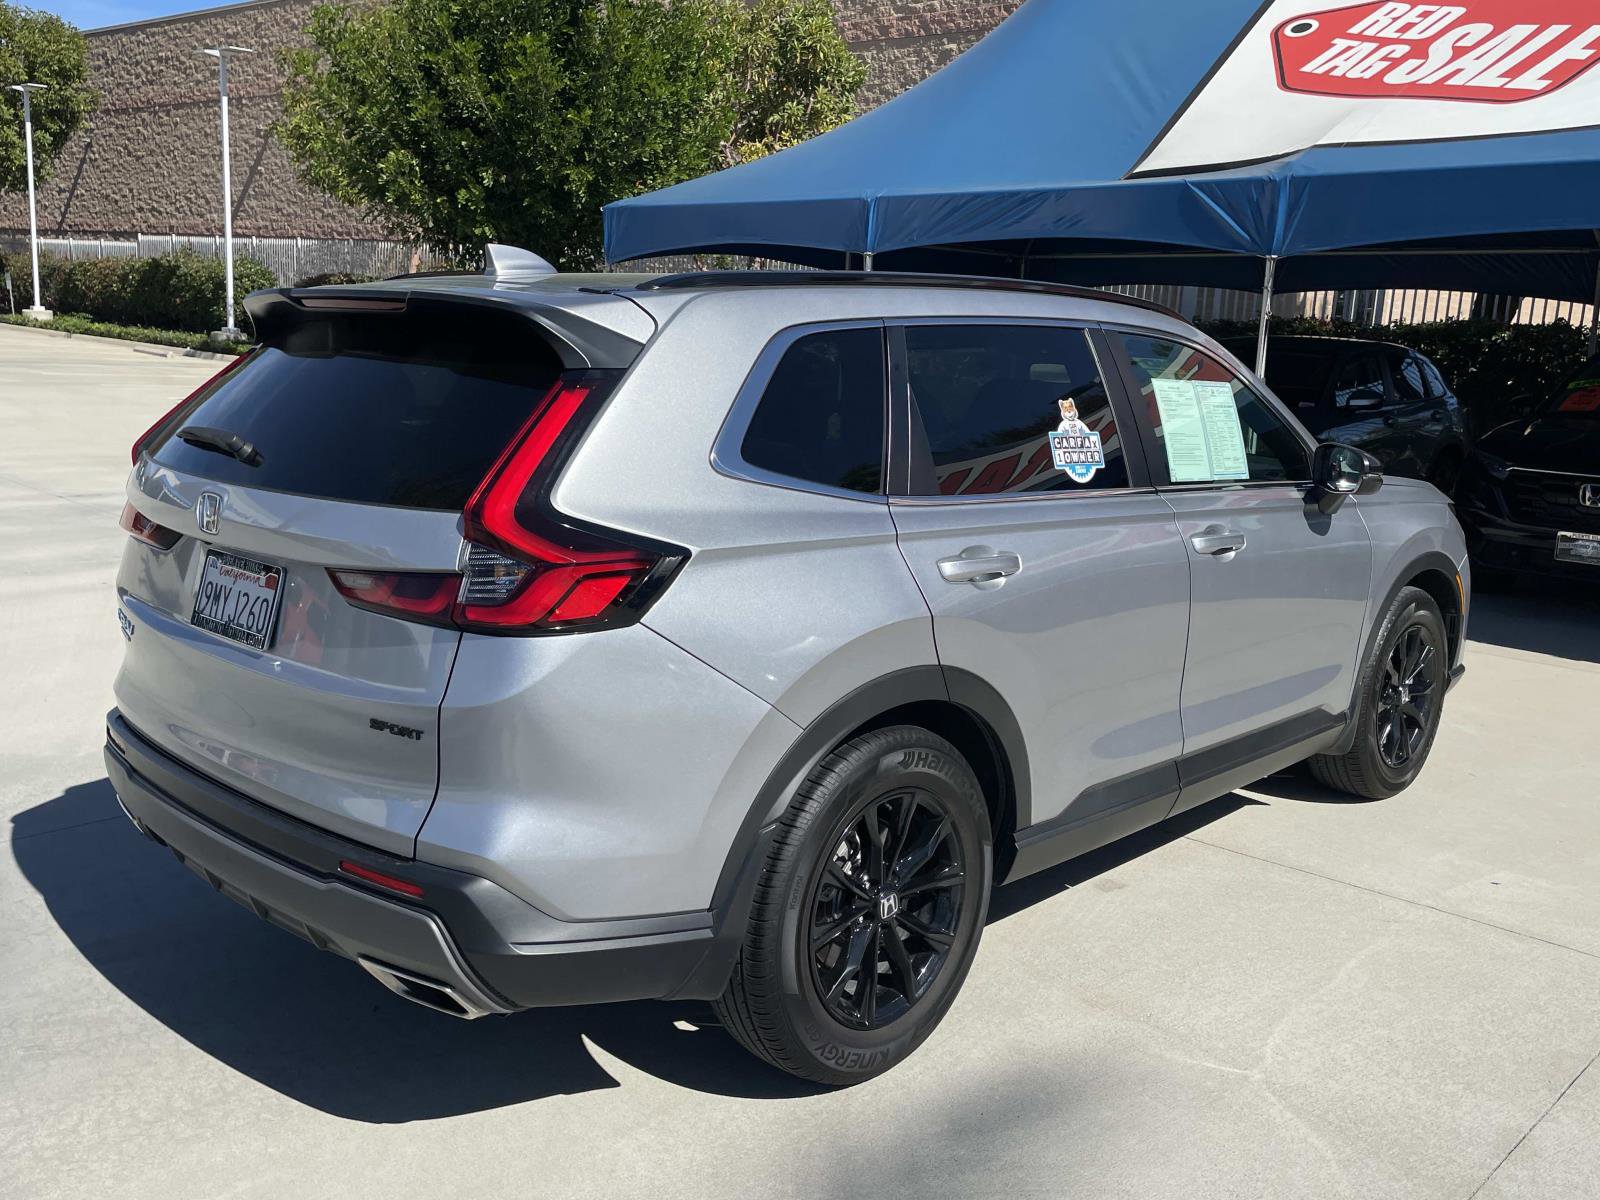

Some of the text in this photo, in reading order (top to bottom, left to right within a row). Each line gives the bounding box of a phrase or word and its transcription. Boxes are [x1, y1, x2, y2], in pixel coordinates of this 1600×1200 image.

[1346, 2, 1467, 40] RED
[1299, 38, 1411, 81] TAG
[1383, 23, 1600, 91] SALE
[1054, 436, 1099, 449] CARFAX
[1056, 451, 1101, 464] 1 OWNER
[219, 565, 261, 586] California
[199, 580, 270, 633] 9MYJ260
[369, 718, 424, 740] SPORT
